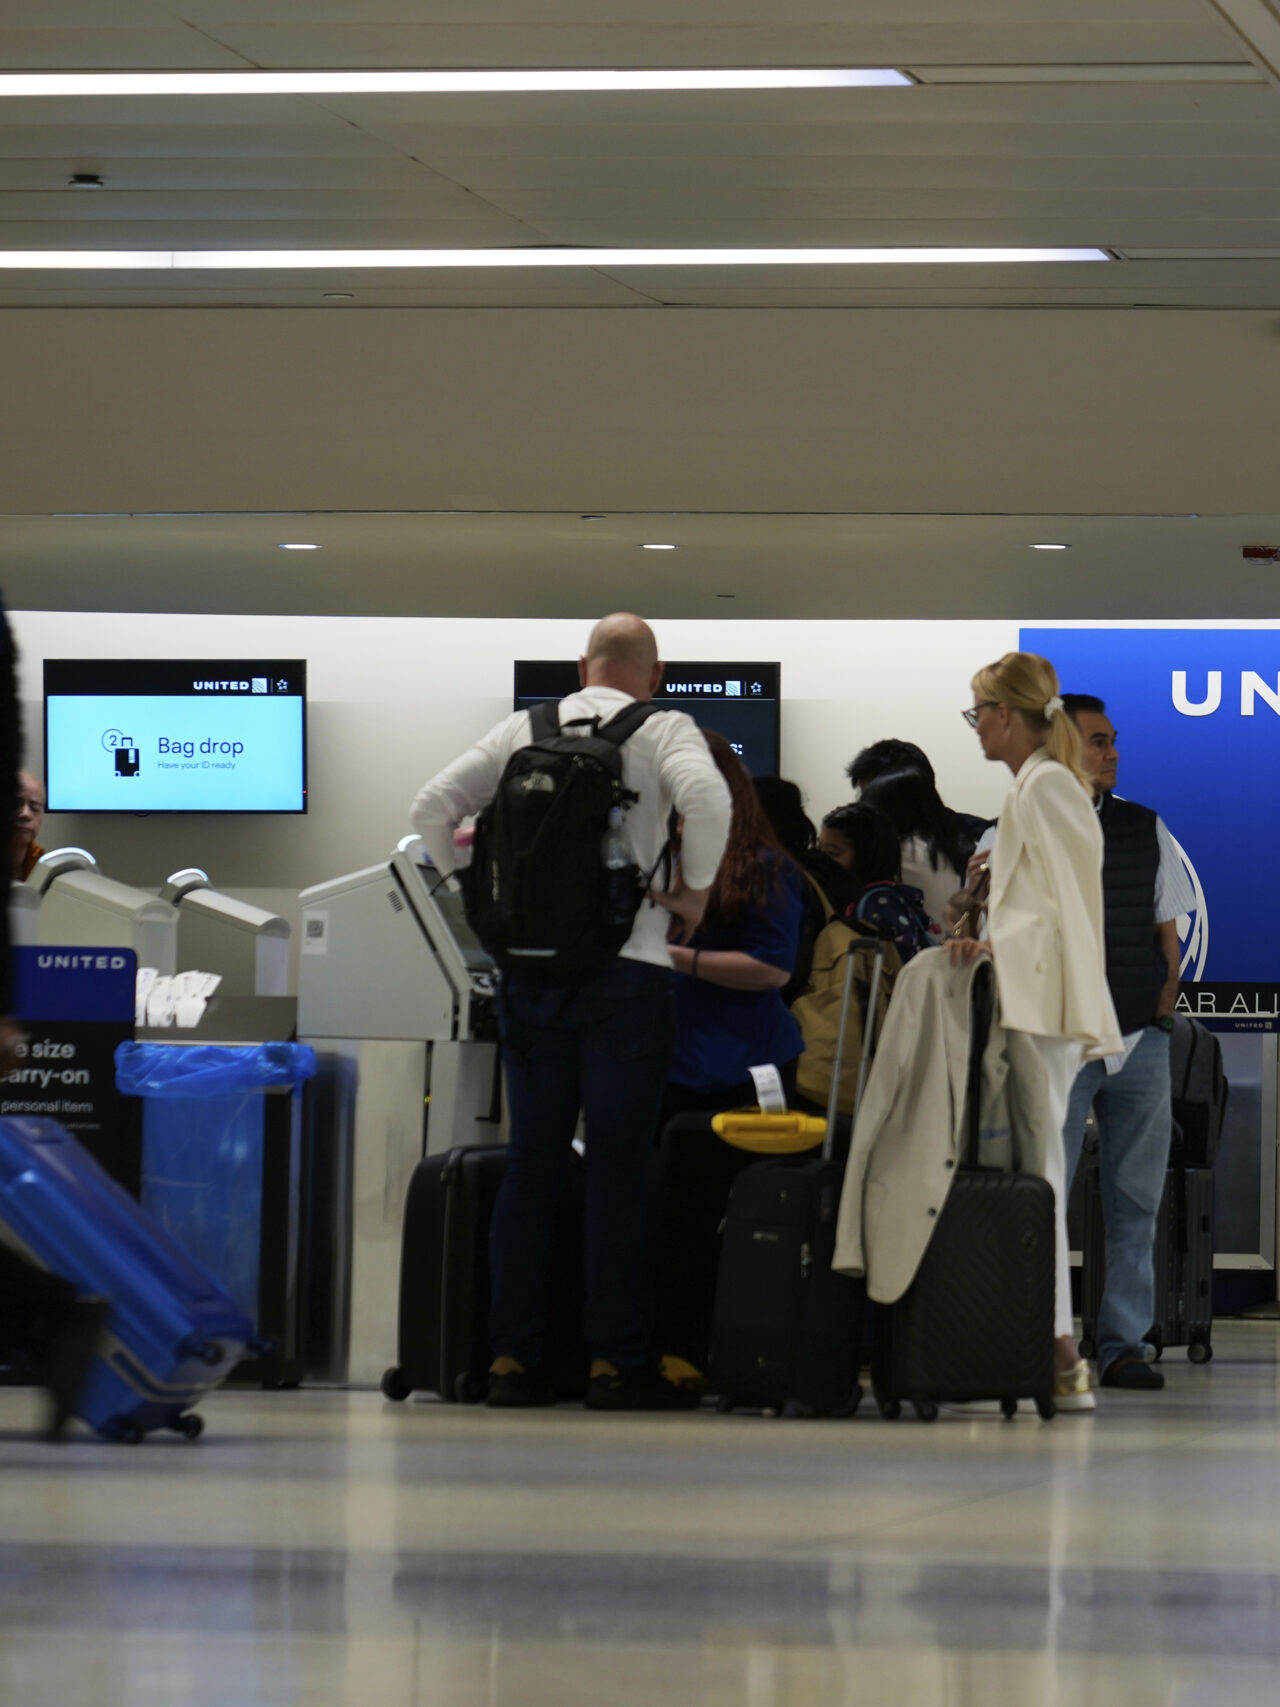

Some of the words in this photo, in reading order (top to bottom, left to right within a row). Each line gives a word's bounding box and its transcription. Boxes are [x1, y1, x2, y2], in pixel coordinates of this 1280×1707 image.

[193, 681, 250, 690] UNITED
[666, 683, 723, 692] UNITED
[109, 735, 117, 746] 2
[158, 737, 194, 758] Bag
[199, 737, 244, 758] drop
[157, 761, 179, 769] Have
[180, 762, 199, 770] your
[201, 761, 210, 769] ID
[212, 761, 236, 770] ready
[37, 955, 126, 969] UNITED
[1174, 992, 1216, 1015] AR
[32, 1039, 75, 1058] size
[0, 1068, 90, 1088] arry-on
[1, 1099, 58, 1113] personal
[61, 1099, 93, 1112] item
